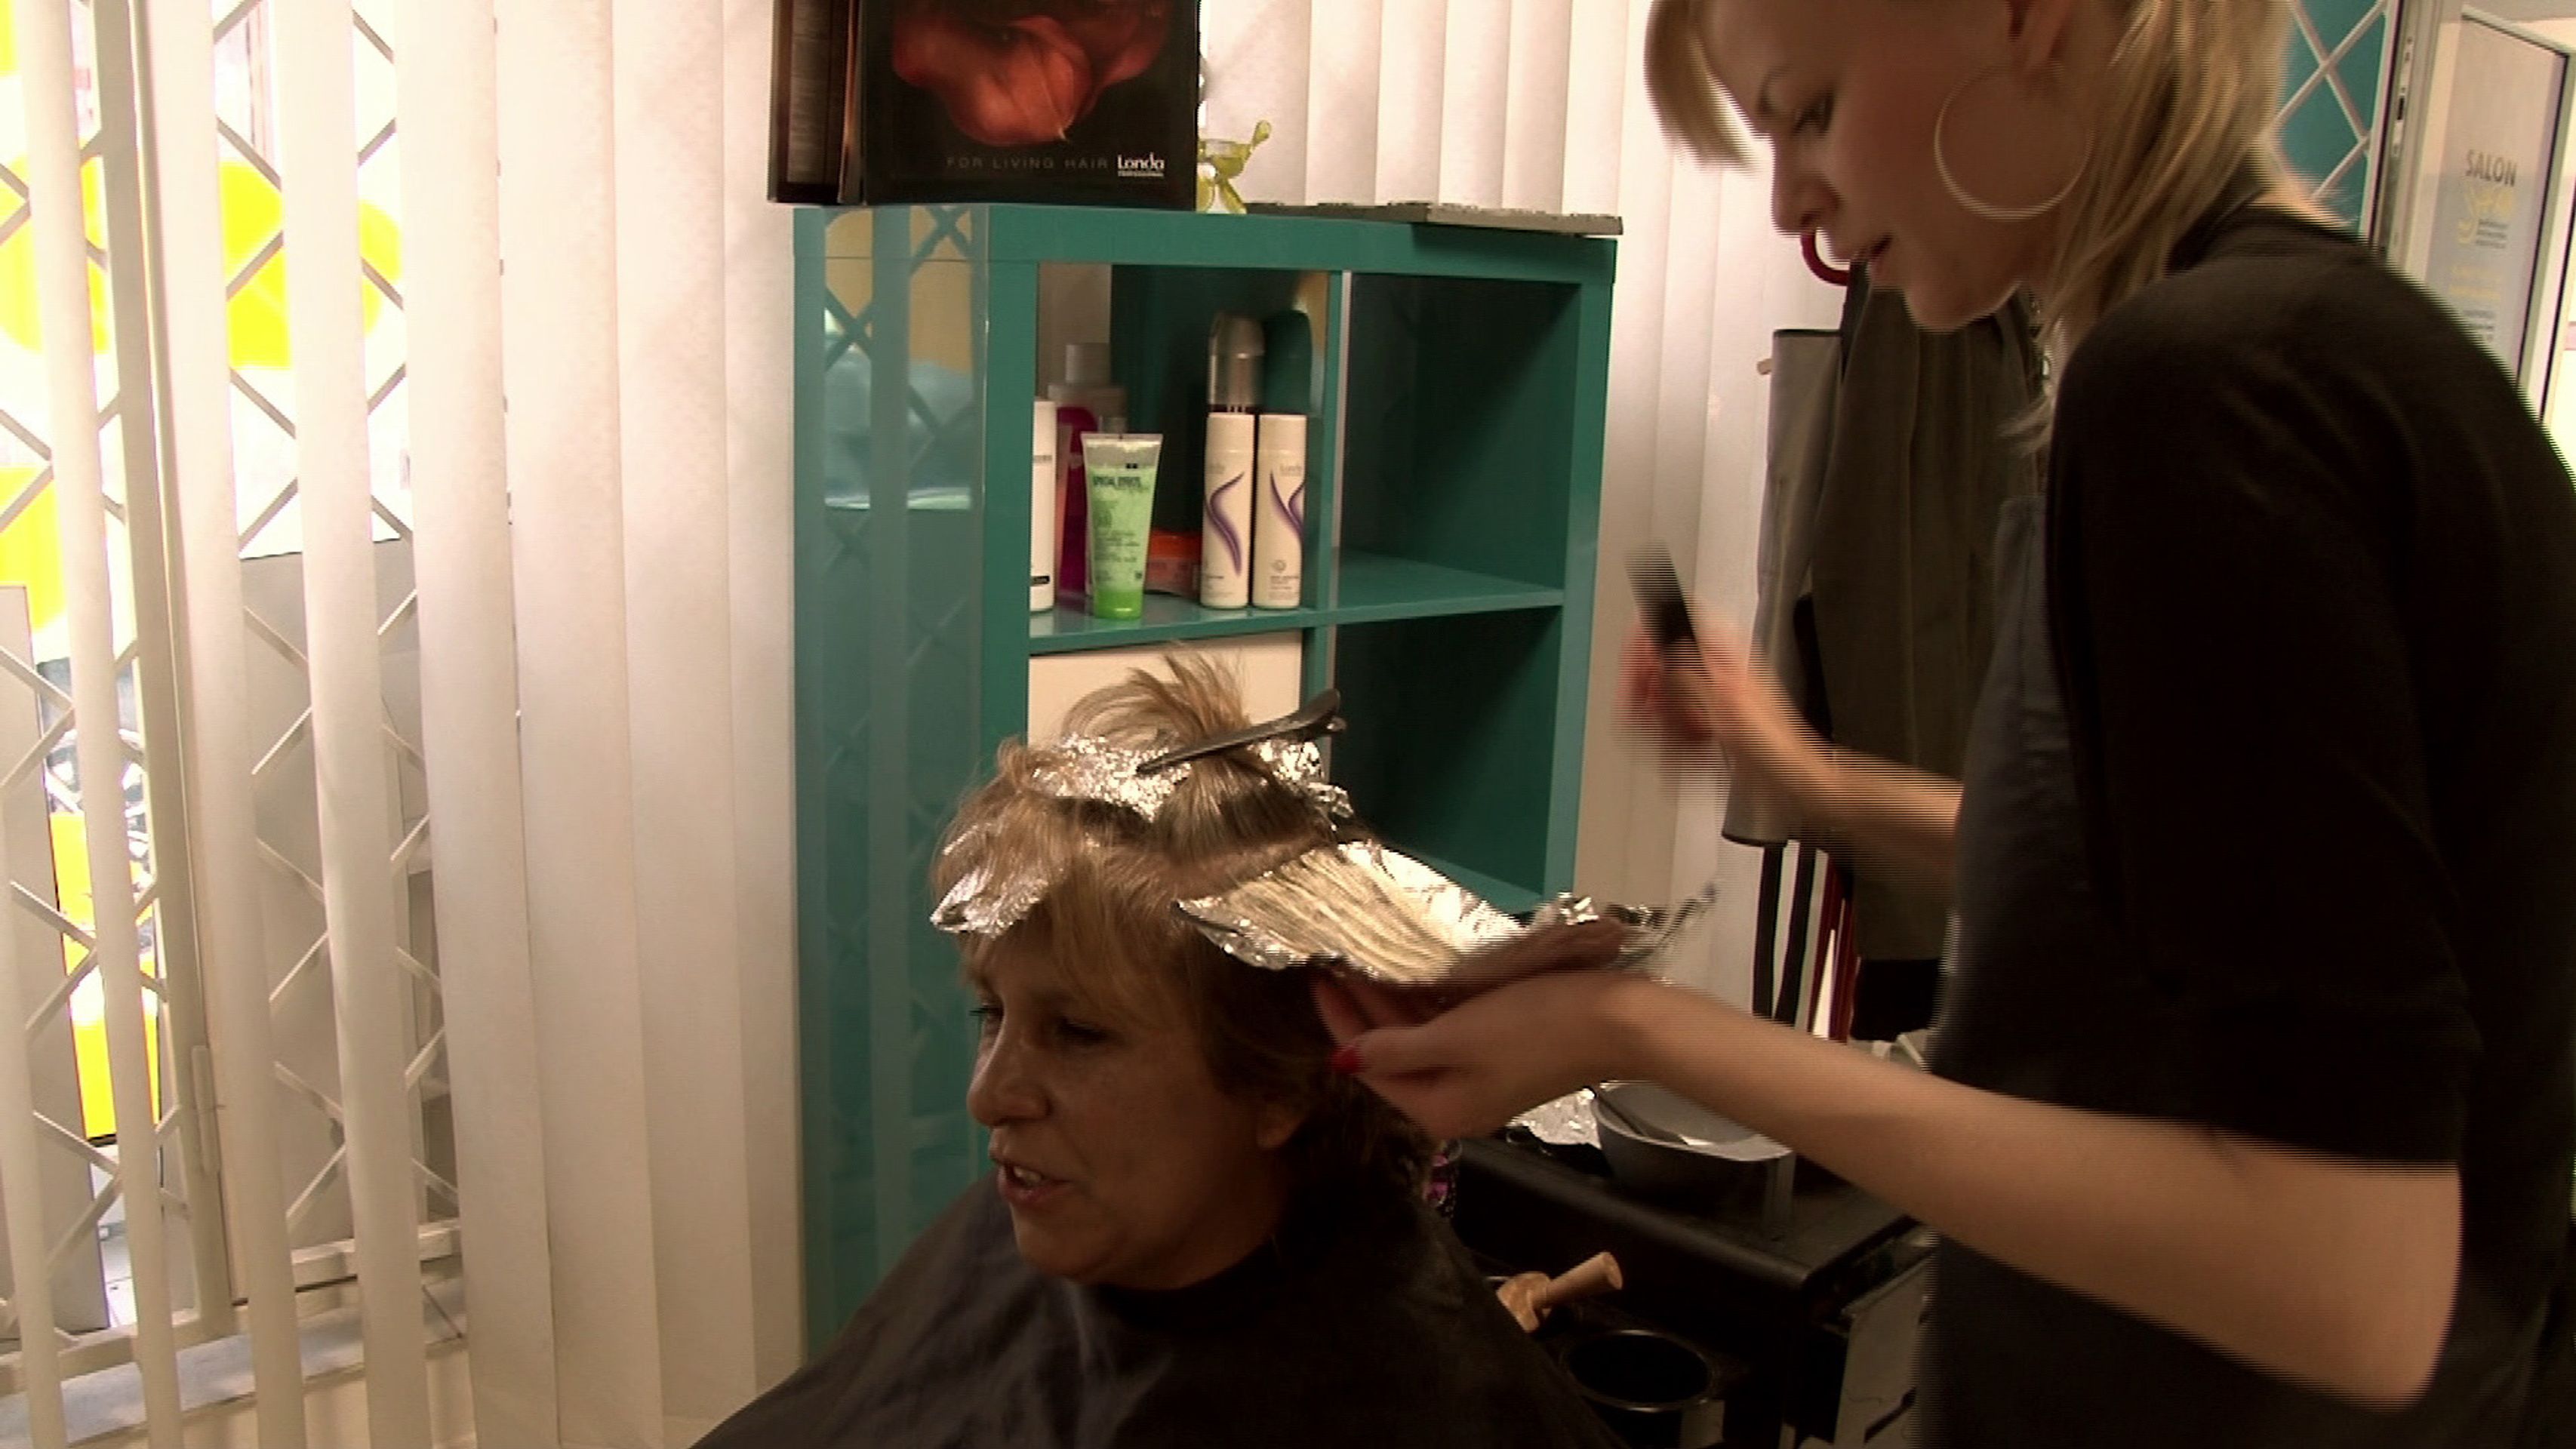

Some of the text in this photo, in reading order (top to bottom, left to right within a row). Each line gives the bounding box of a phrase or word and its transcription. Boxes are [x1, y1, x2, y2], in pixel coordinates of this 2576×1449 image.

[946, 157, 1108, 169] FOR LIVING HAIR
[1117, 152, 1165, 169] Londa
[2465, 149, 2517, 187] SALON
